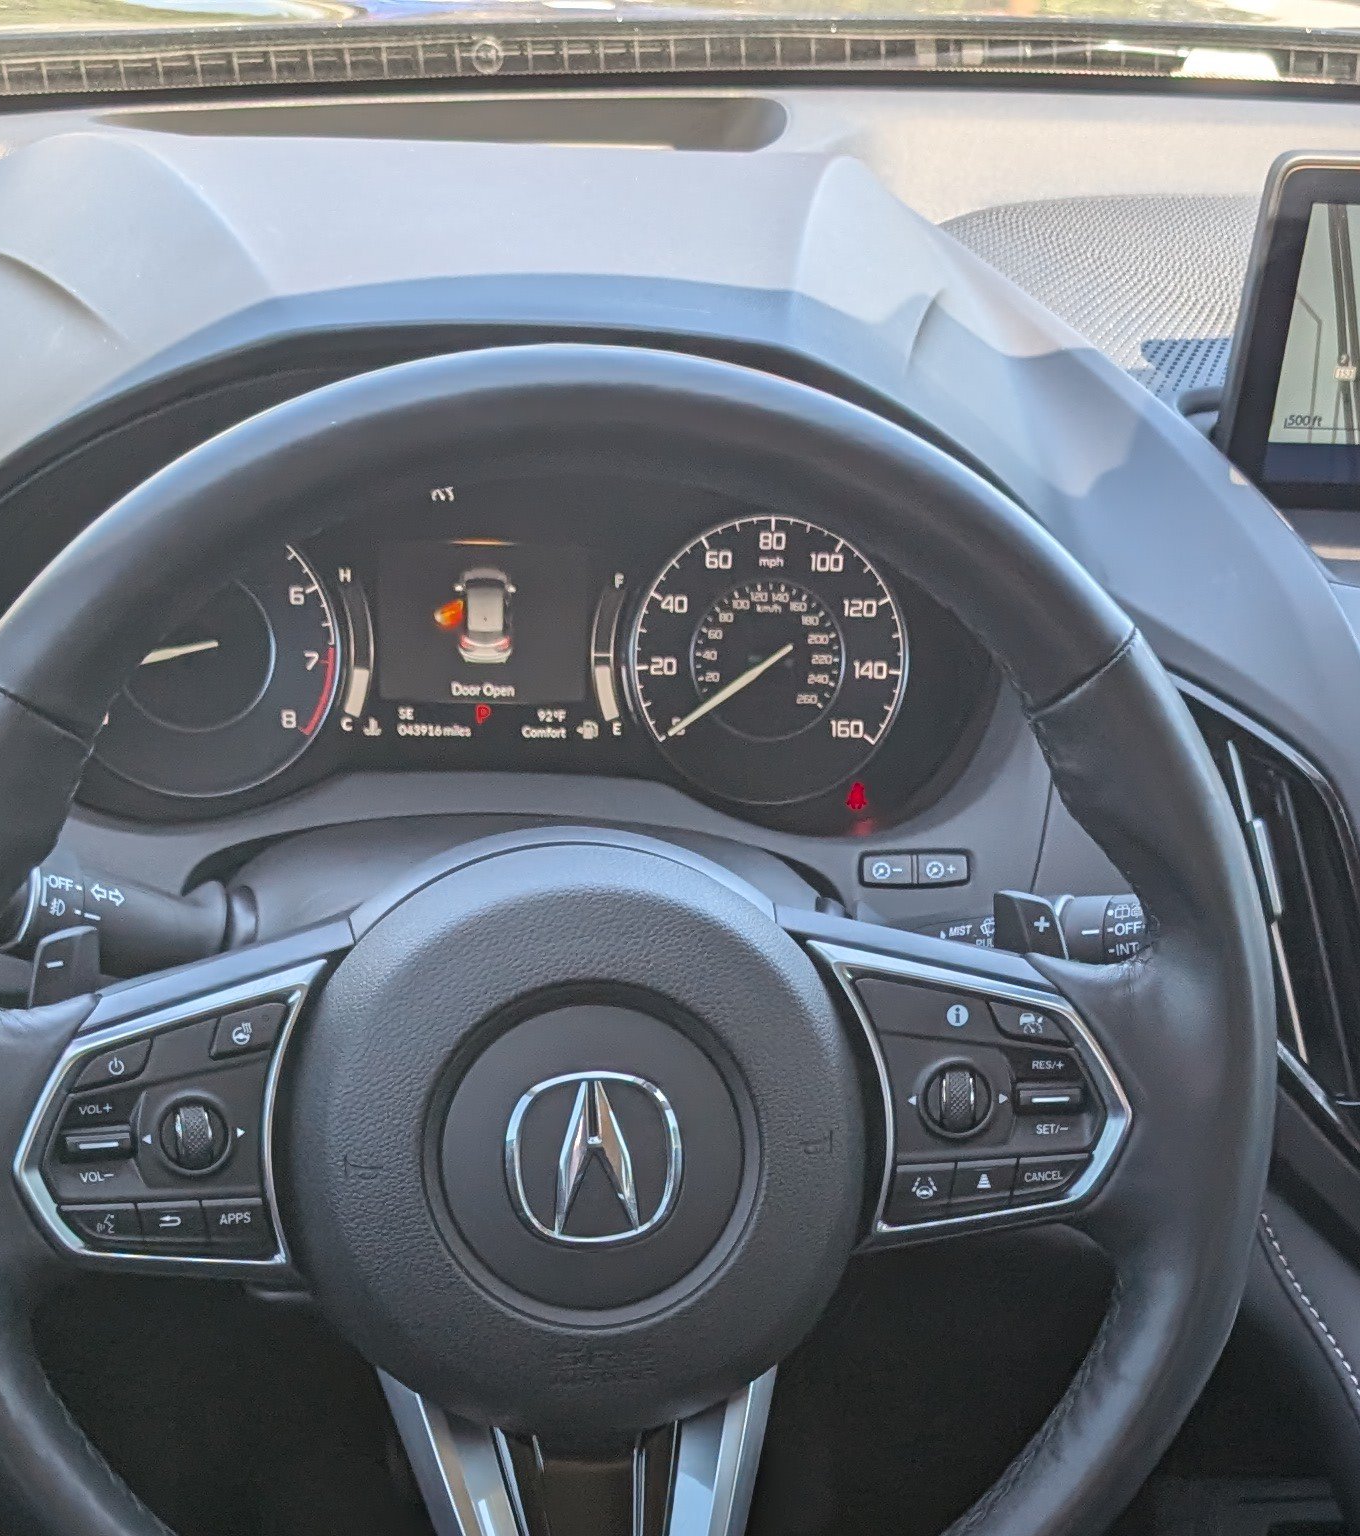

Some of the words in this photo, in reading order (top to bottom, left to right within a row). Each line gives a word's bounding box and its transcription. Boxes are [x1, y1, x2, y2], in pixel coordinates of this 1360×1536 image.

[1287, 414, 1310, 426] 500
[758, 531, 787, 550] 80
[704, 551, 733, 570] 60
[758, 557, 784, 569] mph
[809, 553, 844, 572] 100
[338, 567, 352, 583] H
[288, 585, 305, 605] 6
[749, 591, 769, 603] 120
[771, 591, 790, 603] 140
[660, 594, 688, 614] 40
[732, 599, 751, 611] 100
[756, 602, 783, 615] km/h
[843, 599, 878, 618] 120
[718, 612, 734, 624] 80
[707, 629, 724, 640] 60
[303, 650, 319, 672] 7
[702, 650, 718, 661] 40
[811, 654, 833, 665] 220
[649, 656, 678, 676] 20
[853, 661, 888, 680] 140
[705, 672, 721, 683] 20
[807, 674, 830, 685] 240
[450, 680, 482, 698] Door
[482, 682, 516, 699] Open
[280, 709, 297, 729] 8
[397, 706, 415, 721] SE
[475, 703, 492, 725] P
[536, 708, 567, 723] 92°F
[340, 717, 354, 732] C
[397, 723, 443, 738] 043916
[443, 723, 472, 738] miles
[521, 724, 567, 740] Comfort
[612, 722, 622, 736] E
[829, 719, 865, 739] 160
[47, 874, 74, 892] OFF
[1114, 920, 1143, 937] OFF
[1031, 1059, 1065, 1071] RES/+
[1024, 1170, 1065, 1183] CANCEL
[219, 1212, 252, 1225] APPS
